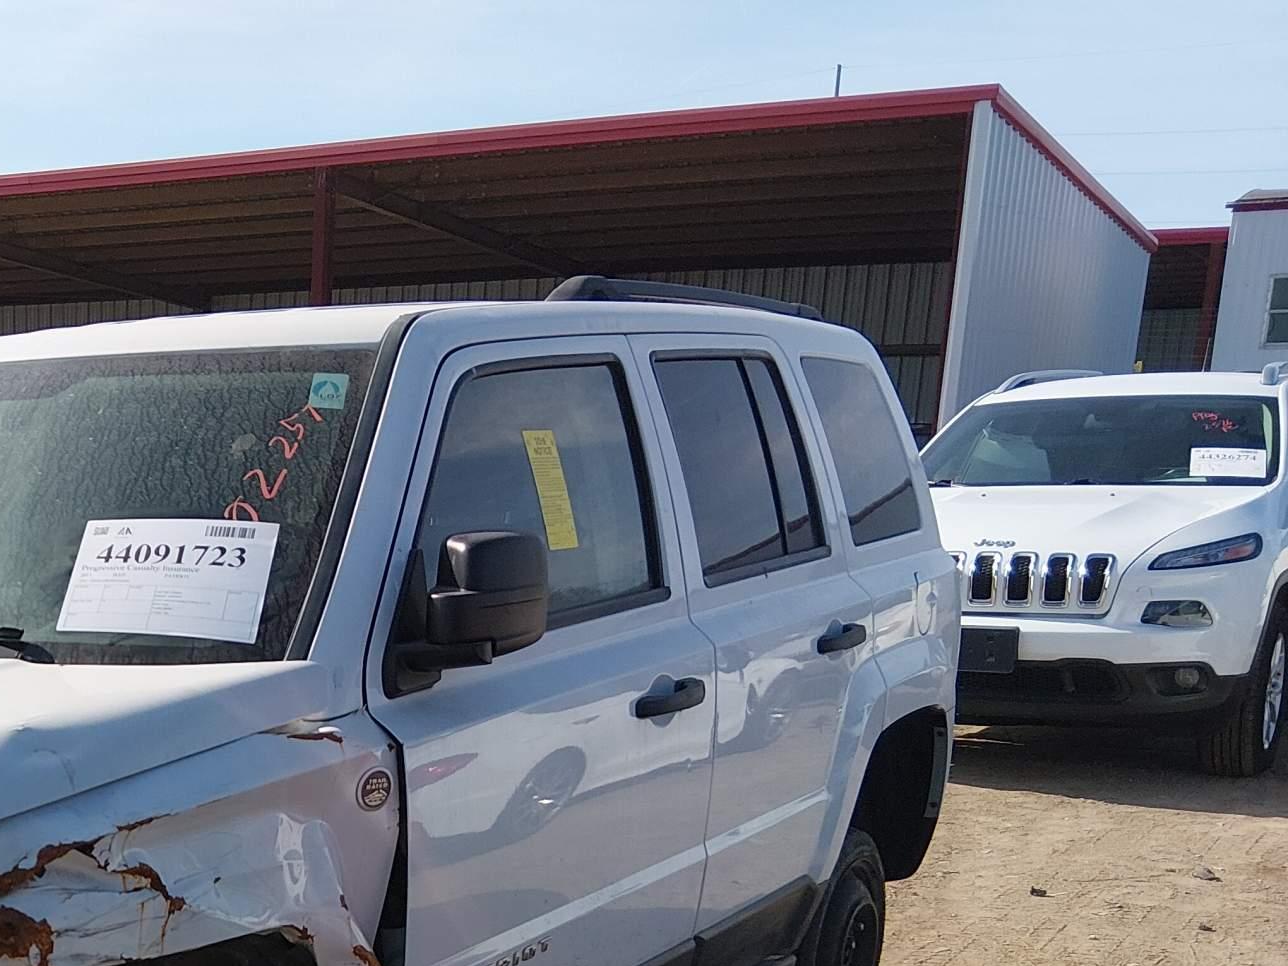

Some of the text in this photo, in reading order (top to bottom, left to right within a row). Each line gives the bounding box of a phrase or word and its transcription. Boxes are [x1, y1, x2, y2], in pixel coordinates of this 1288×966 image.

[973, 538, 1017, 549] Jeep
[95, 543, 247, 568] 44091723
[162, 565, 201, 575] Insurance
